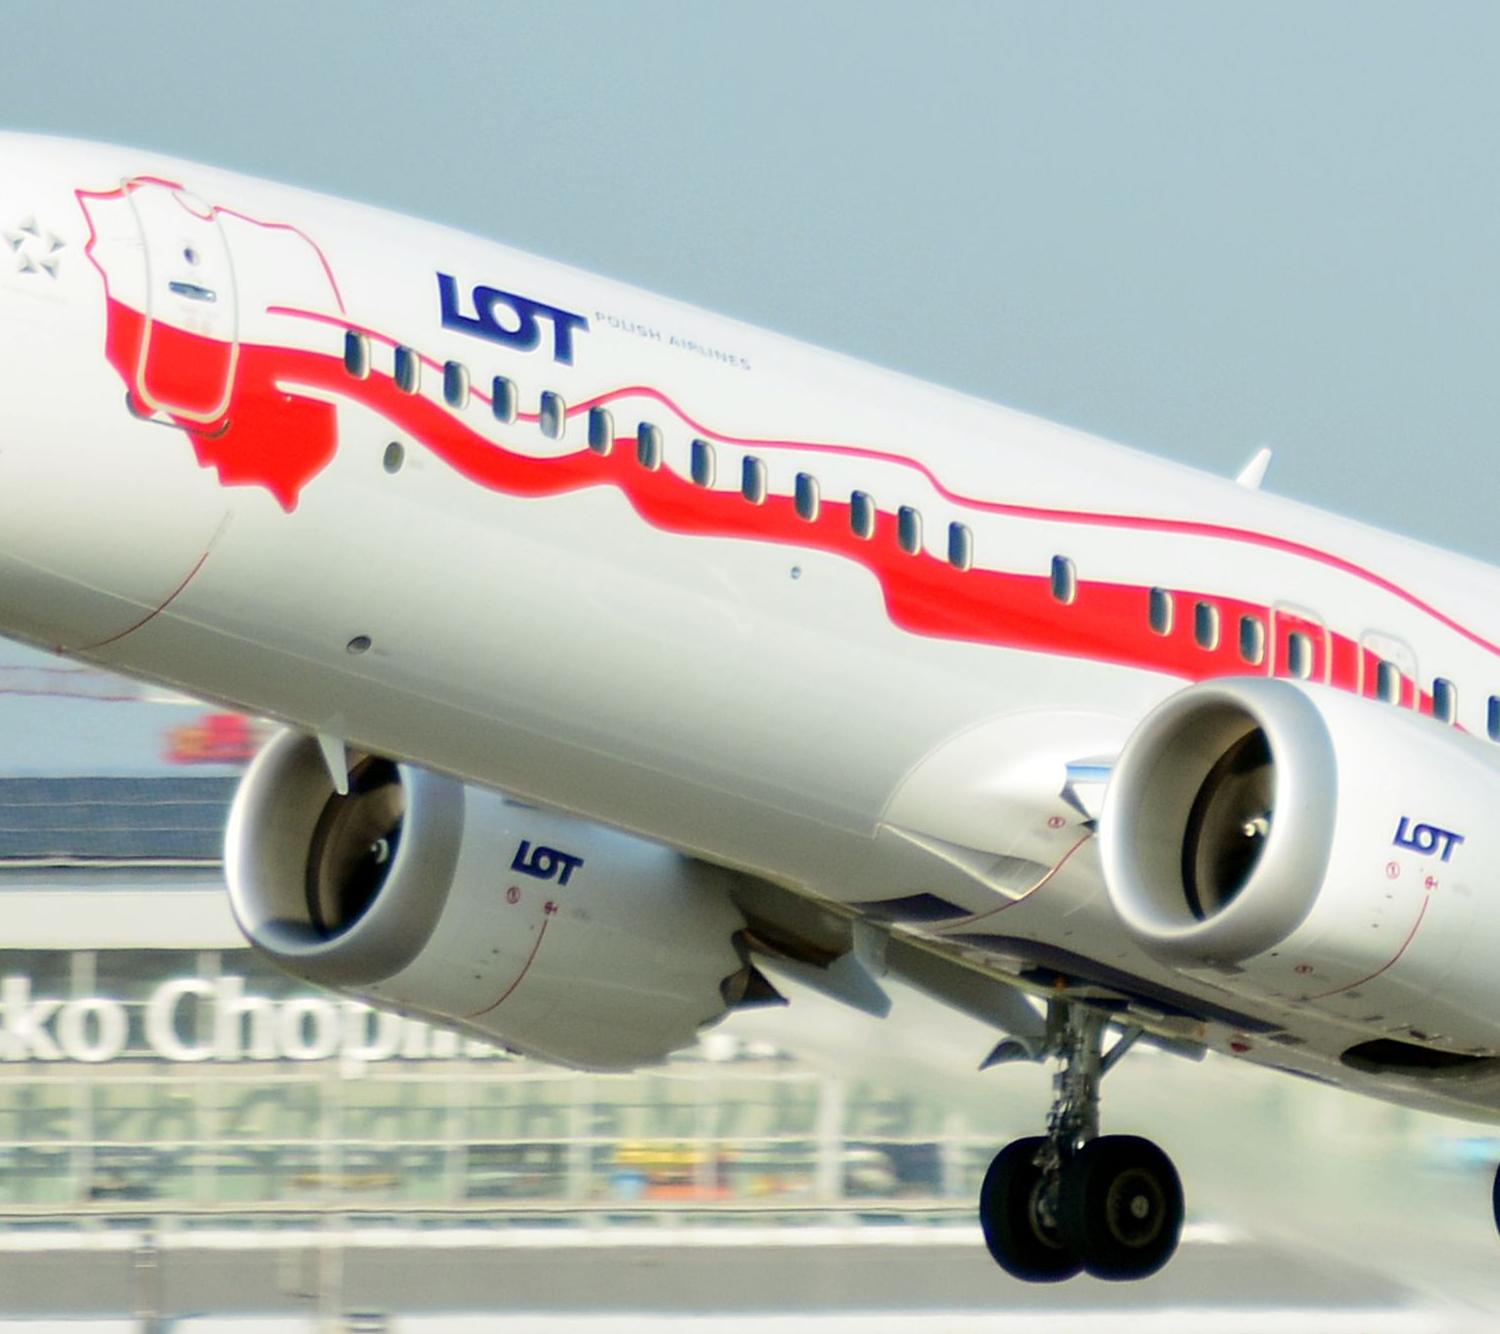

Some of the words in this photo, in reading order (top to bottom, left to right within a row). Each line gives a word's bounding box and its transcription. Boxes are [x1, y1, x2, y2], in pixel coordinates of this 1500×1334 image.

[436, 271, 590, 367] LOT
[595, 311, 662, 342] POLISH
[669, 335, 752, 370] AIRLINES
[511, 839, 585, 886] LOT
[1393, 815, 1465, 863] LOT
